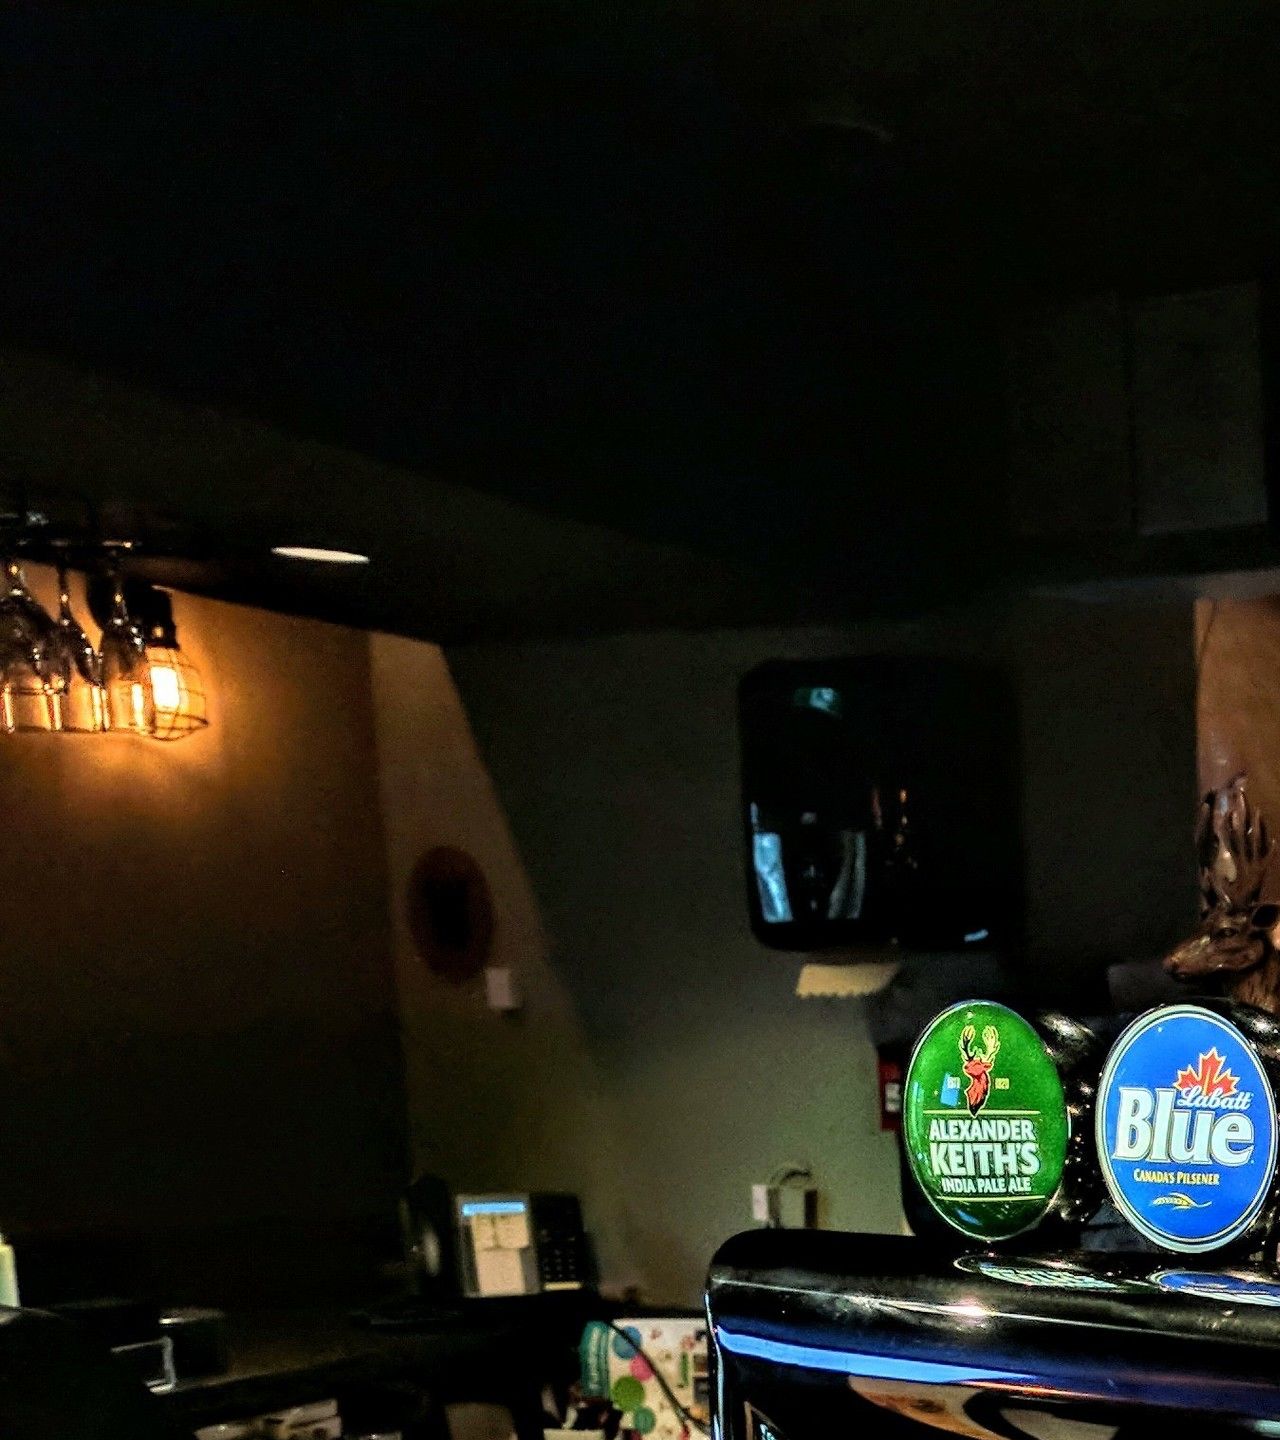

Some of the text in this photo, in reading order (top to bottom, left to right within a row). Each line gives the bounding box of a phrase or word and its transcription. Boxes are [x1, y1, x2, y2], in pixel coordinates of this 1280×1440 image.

[1177, 1087, 1251, 1111] Labatt
[929, 1118, 1034, 1142] ALEXANDER
[1113, 1086, 1255, 1167] Blue
[929, 1139, 1041, 1178] KEITH'S
[941, 1176, 1033, 1194] INDIA PALE ALE
[1133, 1169, 1219, 1186] CANADA'S PILSENER
